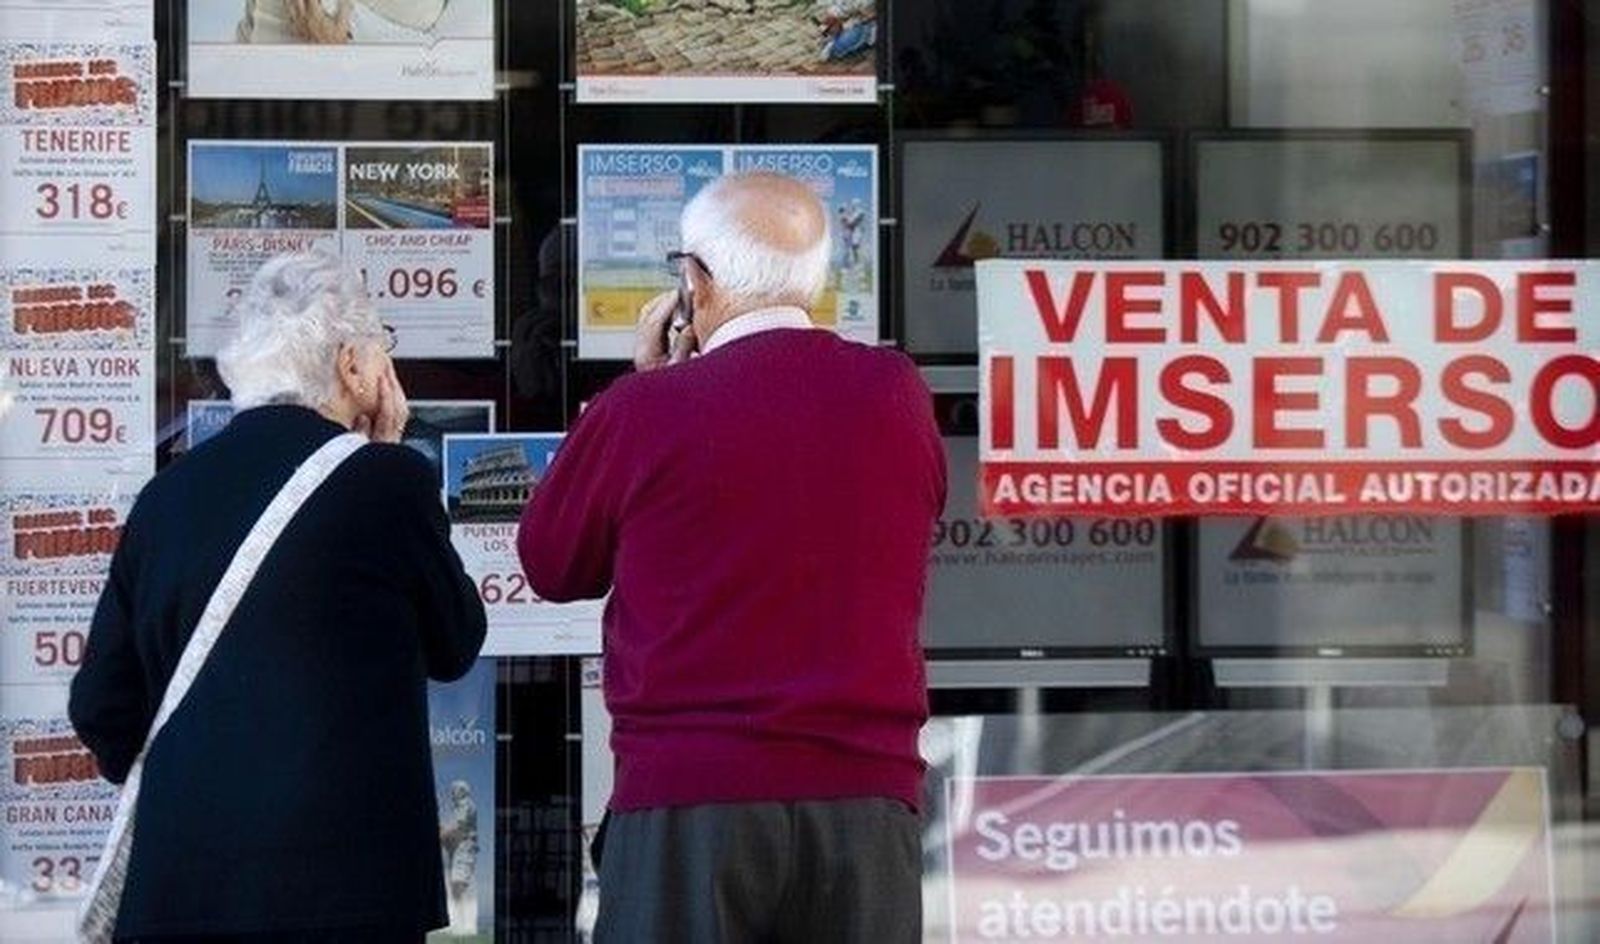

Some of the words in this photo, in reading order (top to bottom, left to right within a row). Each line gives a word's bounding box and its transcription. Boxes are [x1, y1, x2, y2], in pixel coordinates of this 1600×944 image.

[21, 130, 131, 152] TENERIFE
[350, 163, 399, 181] NEW
[406, 163, 459, 180] YORK
[589, 153, 684, 174] IMSERSO
[739, 153, 833, 173] IMSERSO
[36, 183, 128, 219] 318€
[366, 234, 395, 247] CHIC
[400, 234, 426, 247] AND
[430, 234, 473, 246] CHEAP
[1007, 223, 1136, 250] HALCON
[1220, 222, 1281, 250] 902
[1299, 222, 1361, 250] 300
[1374, 222, 1438, 250] 600
[1026, 271, 1389, 344] VENTA
[1434, 271, 1577, 344] DE
[10, 358, 79, 377] NUEVA
[87, 358, 141, 377] YORK
[991, 354, 1600, 451] IMSERSO
[35, 408, 127, 444] 709€
[993, 470, 1173, 505] AGENCIA
[1188, 471, 1344, 504] OFICIAL
[463, 526, 514, 538] PUENTE
[1009, 518, 1074, 547] 300
[1089, 518, 1155, 547] 600
[1303, 517, 1433, 545] HALCON
[484, 539, 509, 552] LOS
[7, 580, 108, 596] FUERTEVEN
[481, 573, 541, 604] 62
[7, 806, 56, 823] GRAN
[64, 804, 119, 822] CANA
[975, 811, 1242, 870] Seguimos
[32, 856, 100, 893] 33
[978, 887, 1338, 939] atendiéndote
